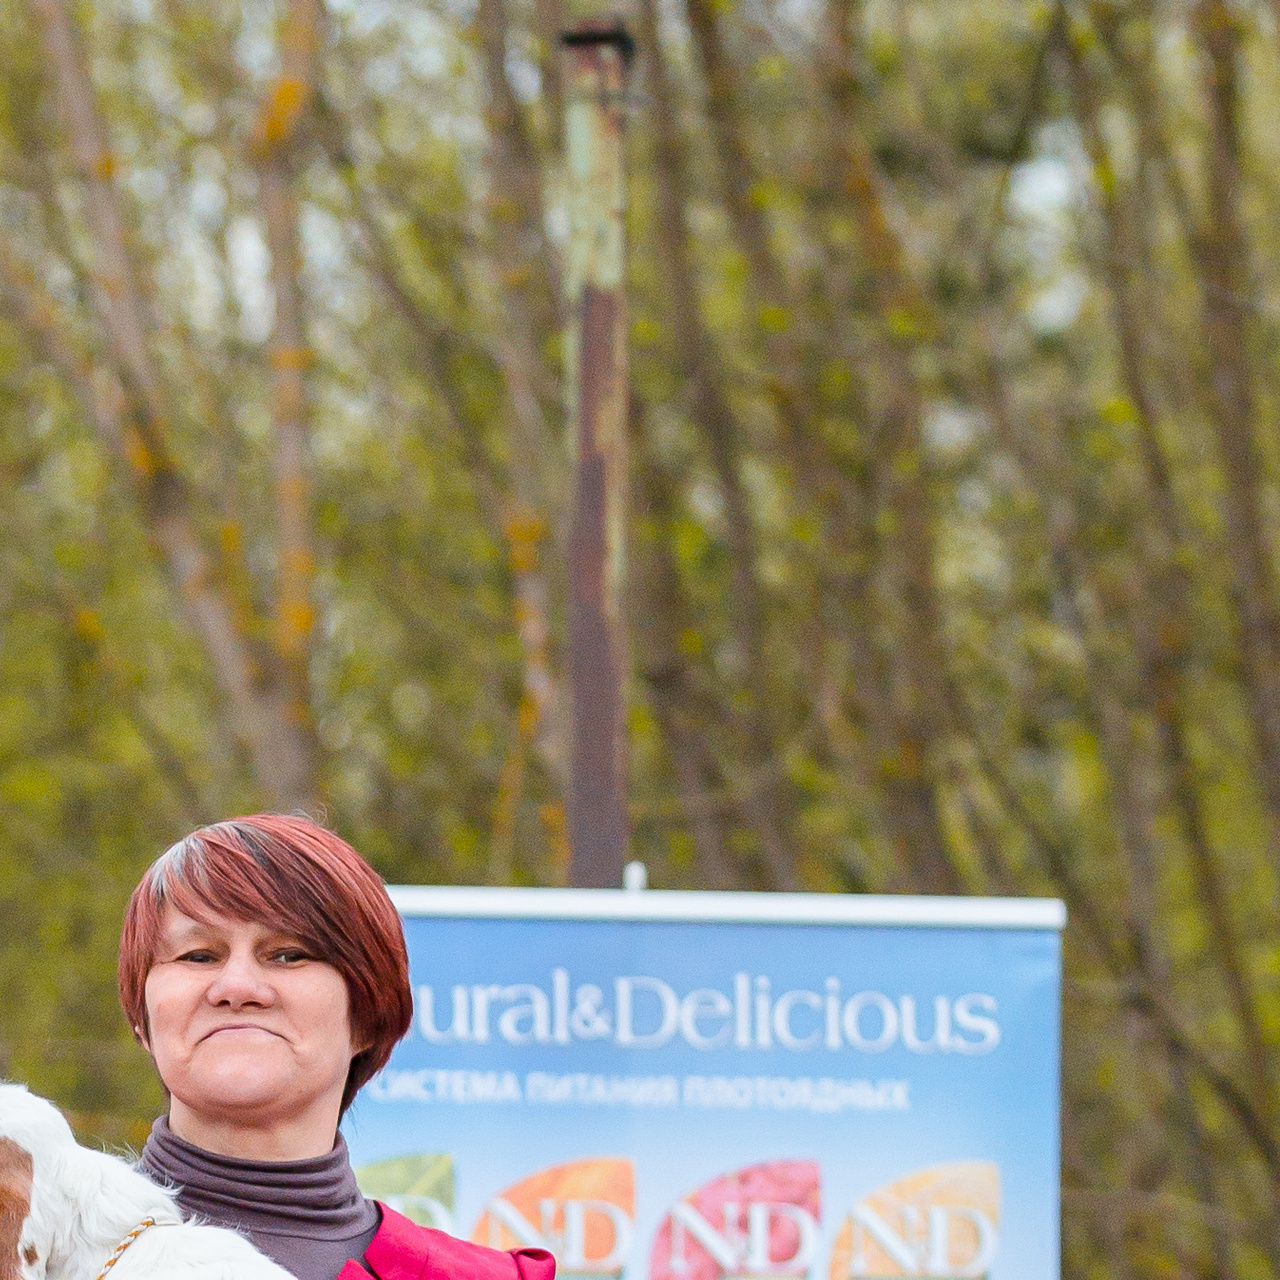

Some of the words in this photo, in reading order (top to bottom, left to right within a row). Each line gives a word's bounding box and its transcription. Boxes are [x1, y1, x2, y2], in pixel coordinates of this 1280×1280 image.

[419, 967, 1003, 1055] ural&Delicious
[668, 1200, 818, 1273] ND
[849, 1202, 999, 1277] ND
